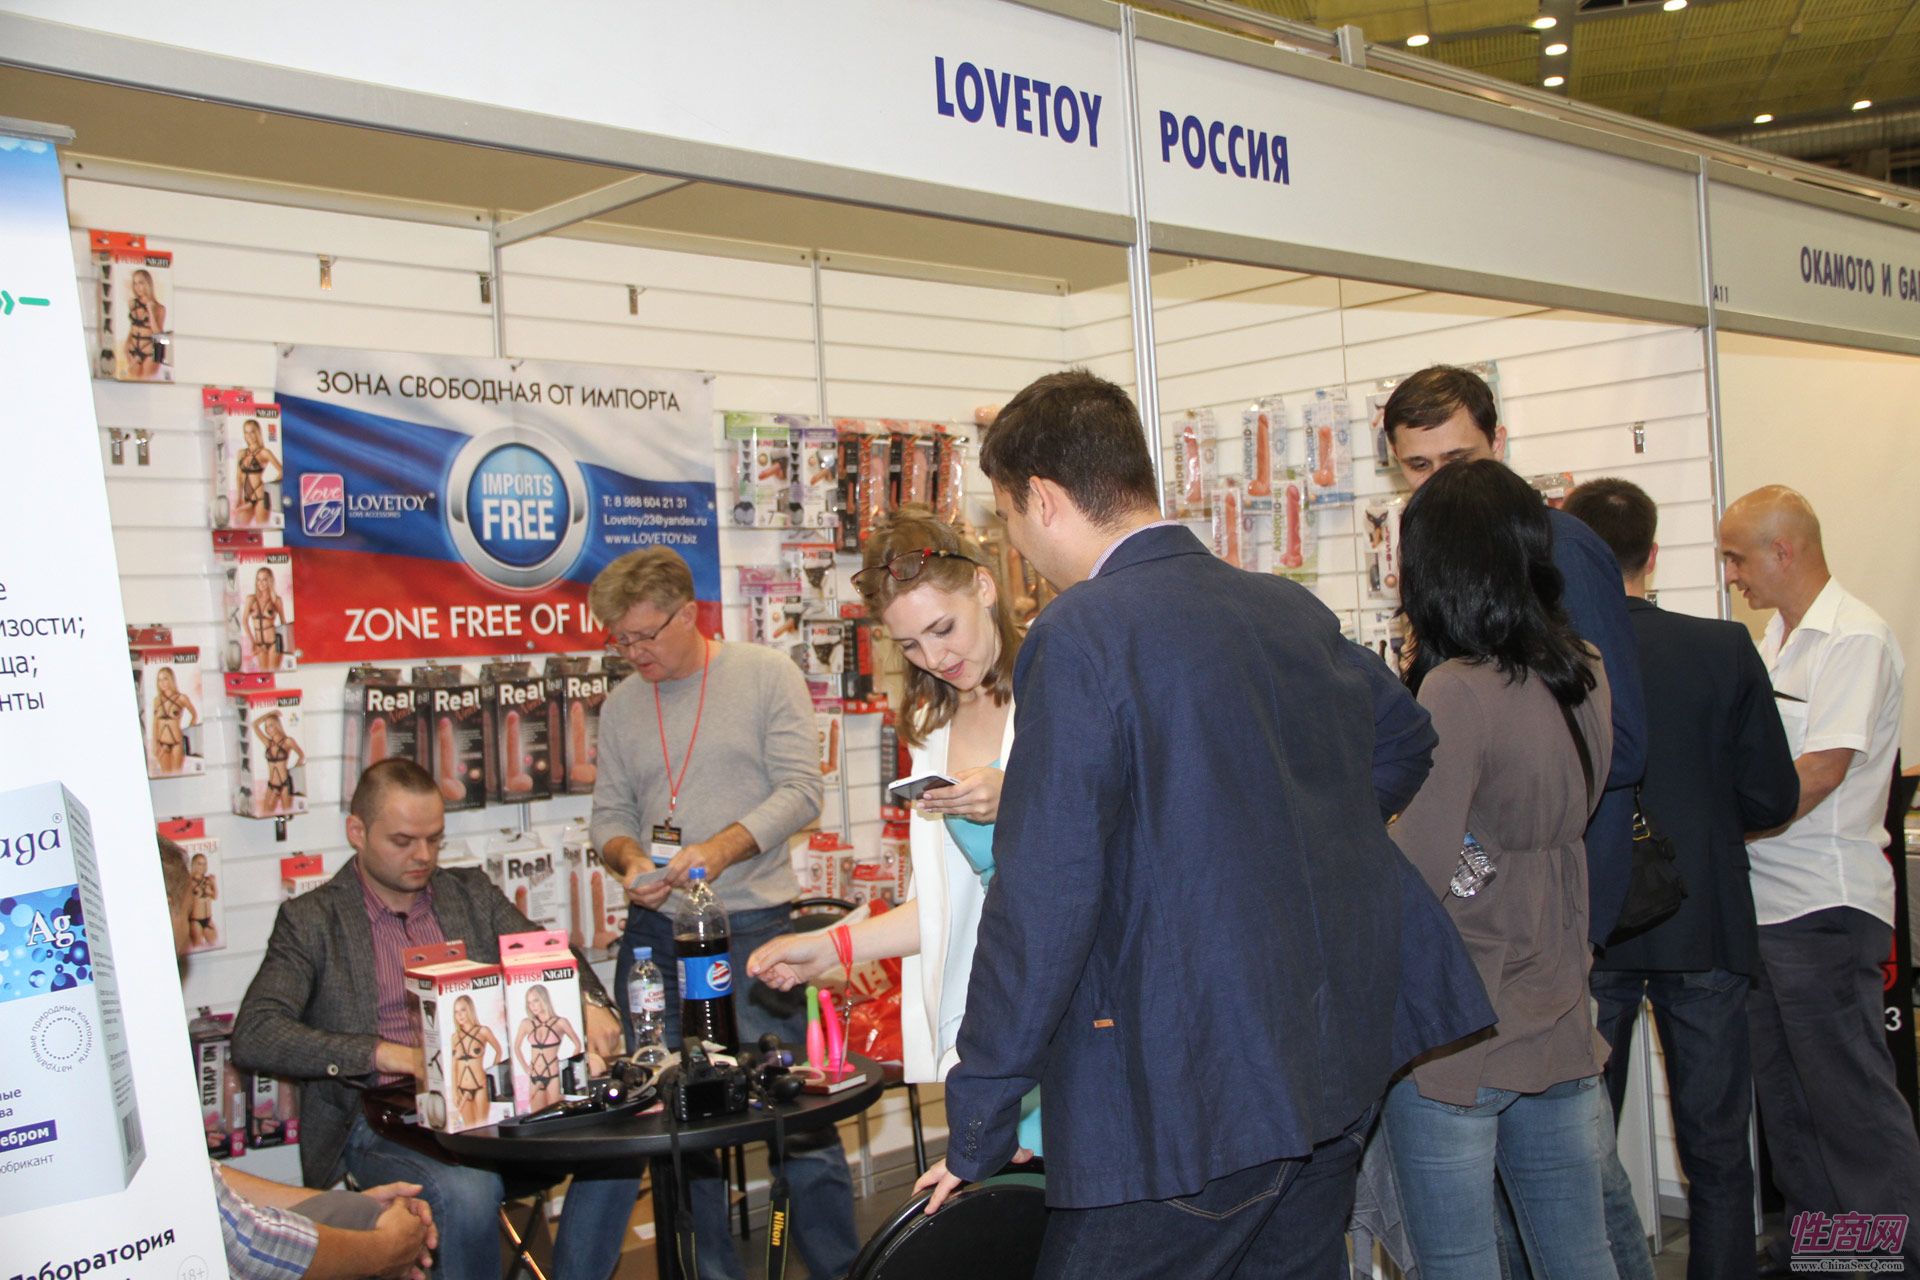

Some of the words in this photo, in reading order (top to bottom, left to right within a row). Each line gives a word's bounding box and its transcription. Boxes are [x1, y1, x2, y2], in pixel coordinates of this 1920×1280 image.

[935, 56, 1102, 148] LOVETOY
[1159, 110, 1290, 185] РОССИЯ
[1801, 246, 1875, 294] OKAMOTO
[1899, 266, 1920, 303] GA
[1713, 285, 1729, 303] A11
[317, 370, 391, 396] ЗОНА
[400, 375, 542, 404] СВОБОДНАЯ
[548, 384, 574, 405] ОТ
[582, 386, 681, 411] ИМПОРТА
[482, 473, 554, 497] IMPORTS
[348, 494, 428, 511] LOVETOY
[482, 498, 556, 540] FREE
[604, 531, 698, 545] www.LOVETOY.biz
[344, 607, 440, 642] ZONE
[450, 605, 522, 638] FREE
[531, 603, 570, 635] OF
[500, 682, 546, 705] Real
[567, 676, 608, 698] Real
[368, 688, 416, 712] Real
[435, 688, 481, 712] Real
[508, 854, 554, 879] Real
[27, 910, 75, 948] Ag
[444, 981, 472, 993] FETISH
[472, 975, 499, 989] NIGHT
[513, 972, 542, 984] FETISH
[543, 968, 573, 982] NIGHT
[31, 1005, 77, 1033] природные
[1884, 1006, 1901, 1031] 3
[203, 1044, 217, 1063] ON
[203, 1066, 217, 1106] STRAP
[771, 1211, 785, 1247] Nikon
[9, 1228, 175, 1280] боратория
